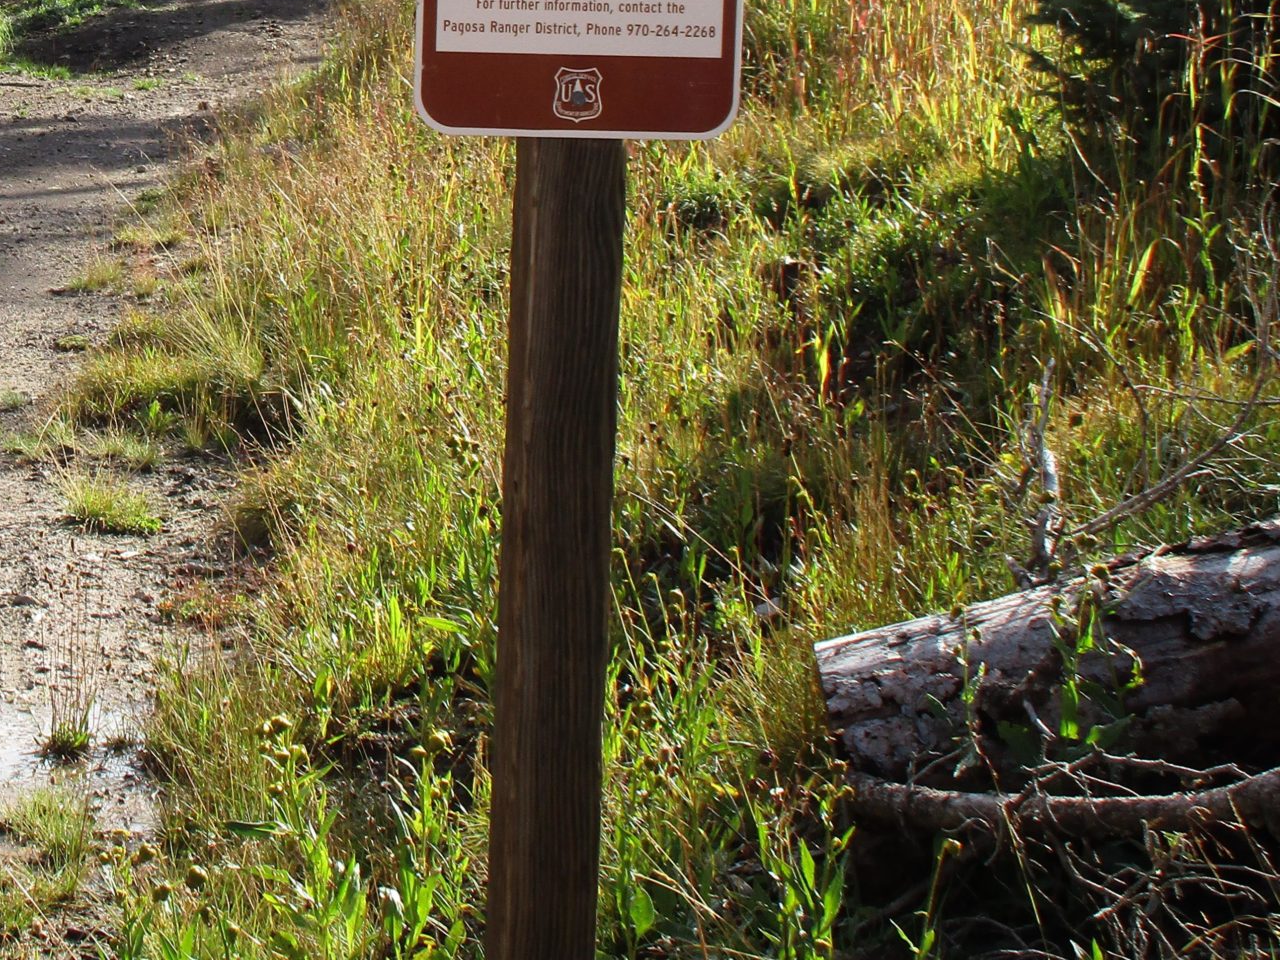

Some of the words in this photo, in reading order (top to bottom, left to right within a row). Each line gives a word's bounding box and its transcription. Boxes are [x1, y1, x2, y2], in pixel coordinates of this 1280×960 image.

[544, 0, 613, 15] information,
[618, 1, 662, 13] contact
[666, 2, 685, 14] the
[443, 20, 485, 35] Pagosa
[490, 21, 530, 37] Ranger
[535, 23, 581, 36] District,
[586, 24, 621, 36] Phone
[627, 24, 716, 38] 970-264-2268
